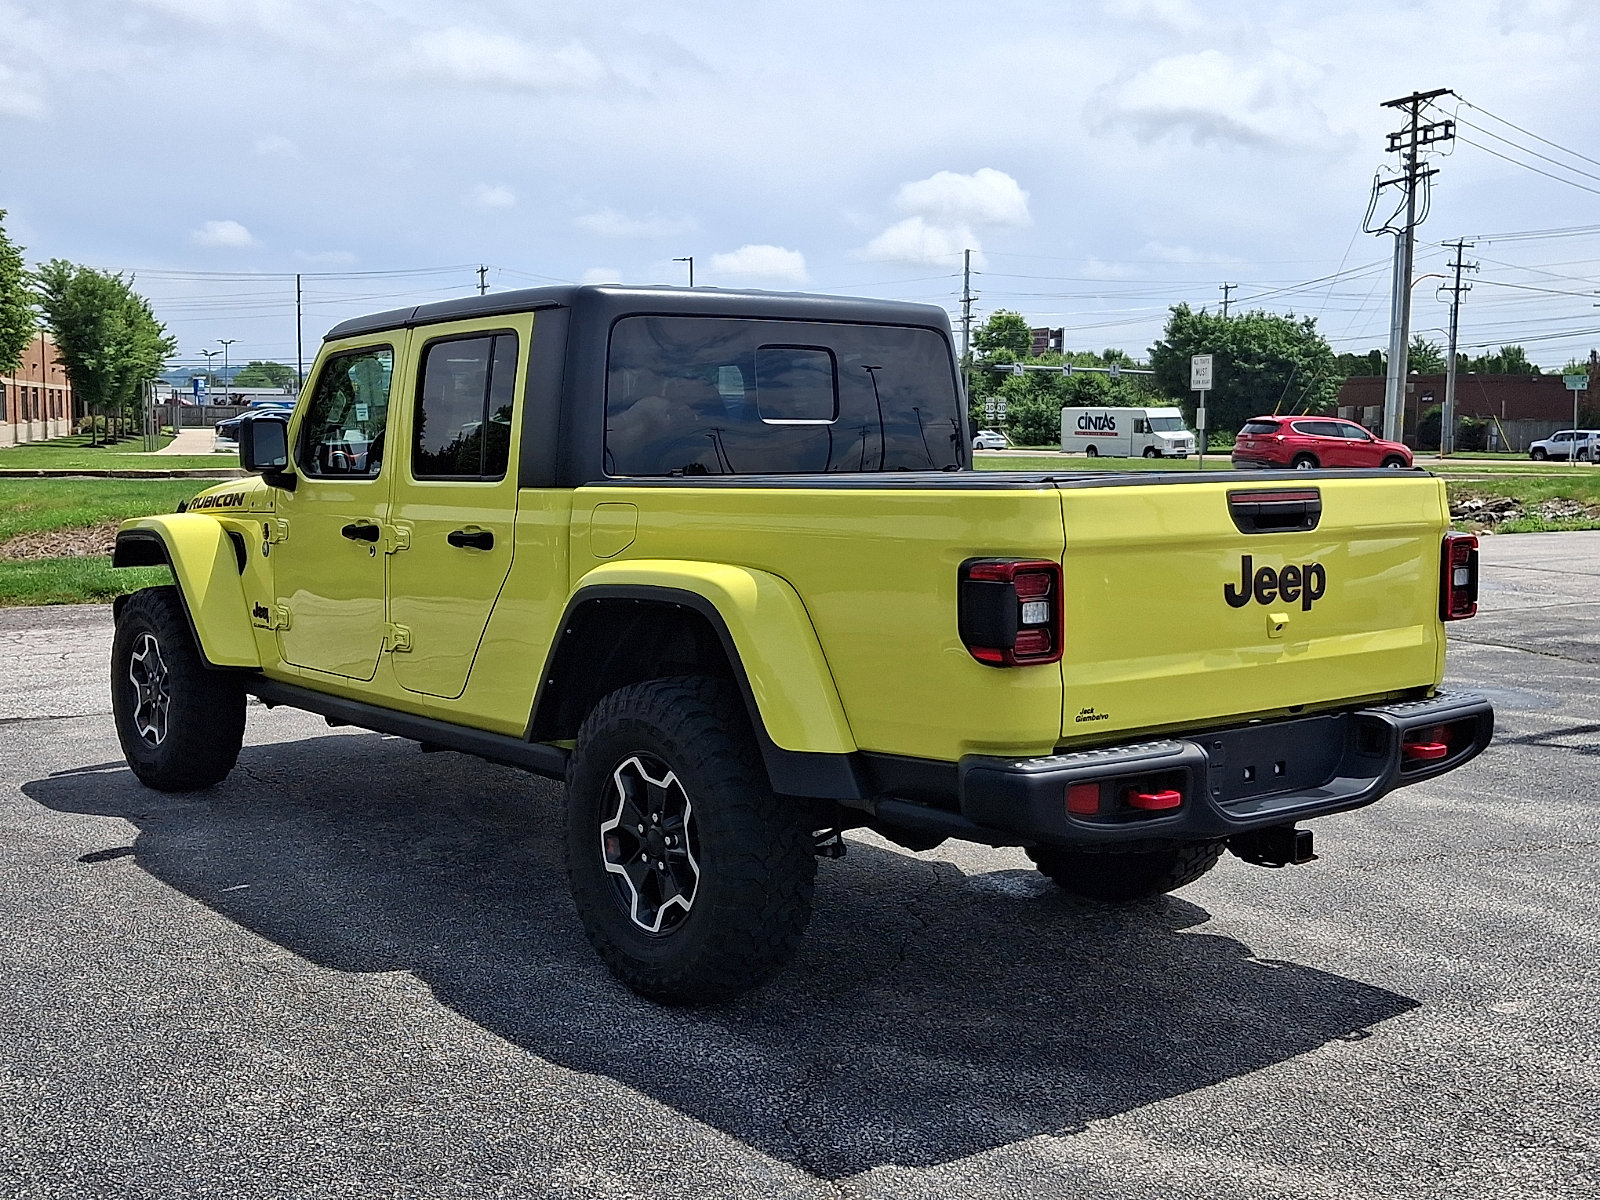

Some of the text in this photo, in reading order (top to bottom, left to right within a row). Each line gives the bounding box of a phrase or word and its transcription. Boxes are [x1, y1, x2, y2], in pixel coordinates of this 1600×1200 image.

[1195, 367, 1208, 376] MUST
[1077, 411, 1116, 431] CINTAS
[188, 492, 246, 510] RUBICON
[1223, 554, 1326, 612] Jeep
[252, 601, 270, 623] Jeep
[1075, 713, 1109, 723] Giambalvo
[1079, 706, 1095, 715] Jack
